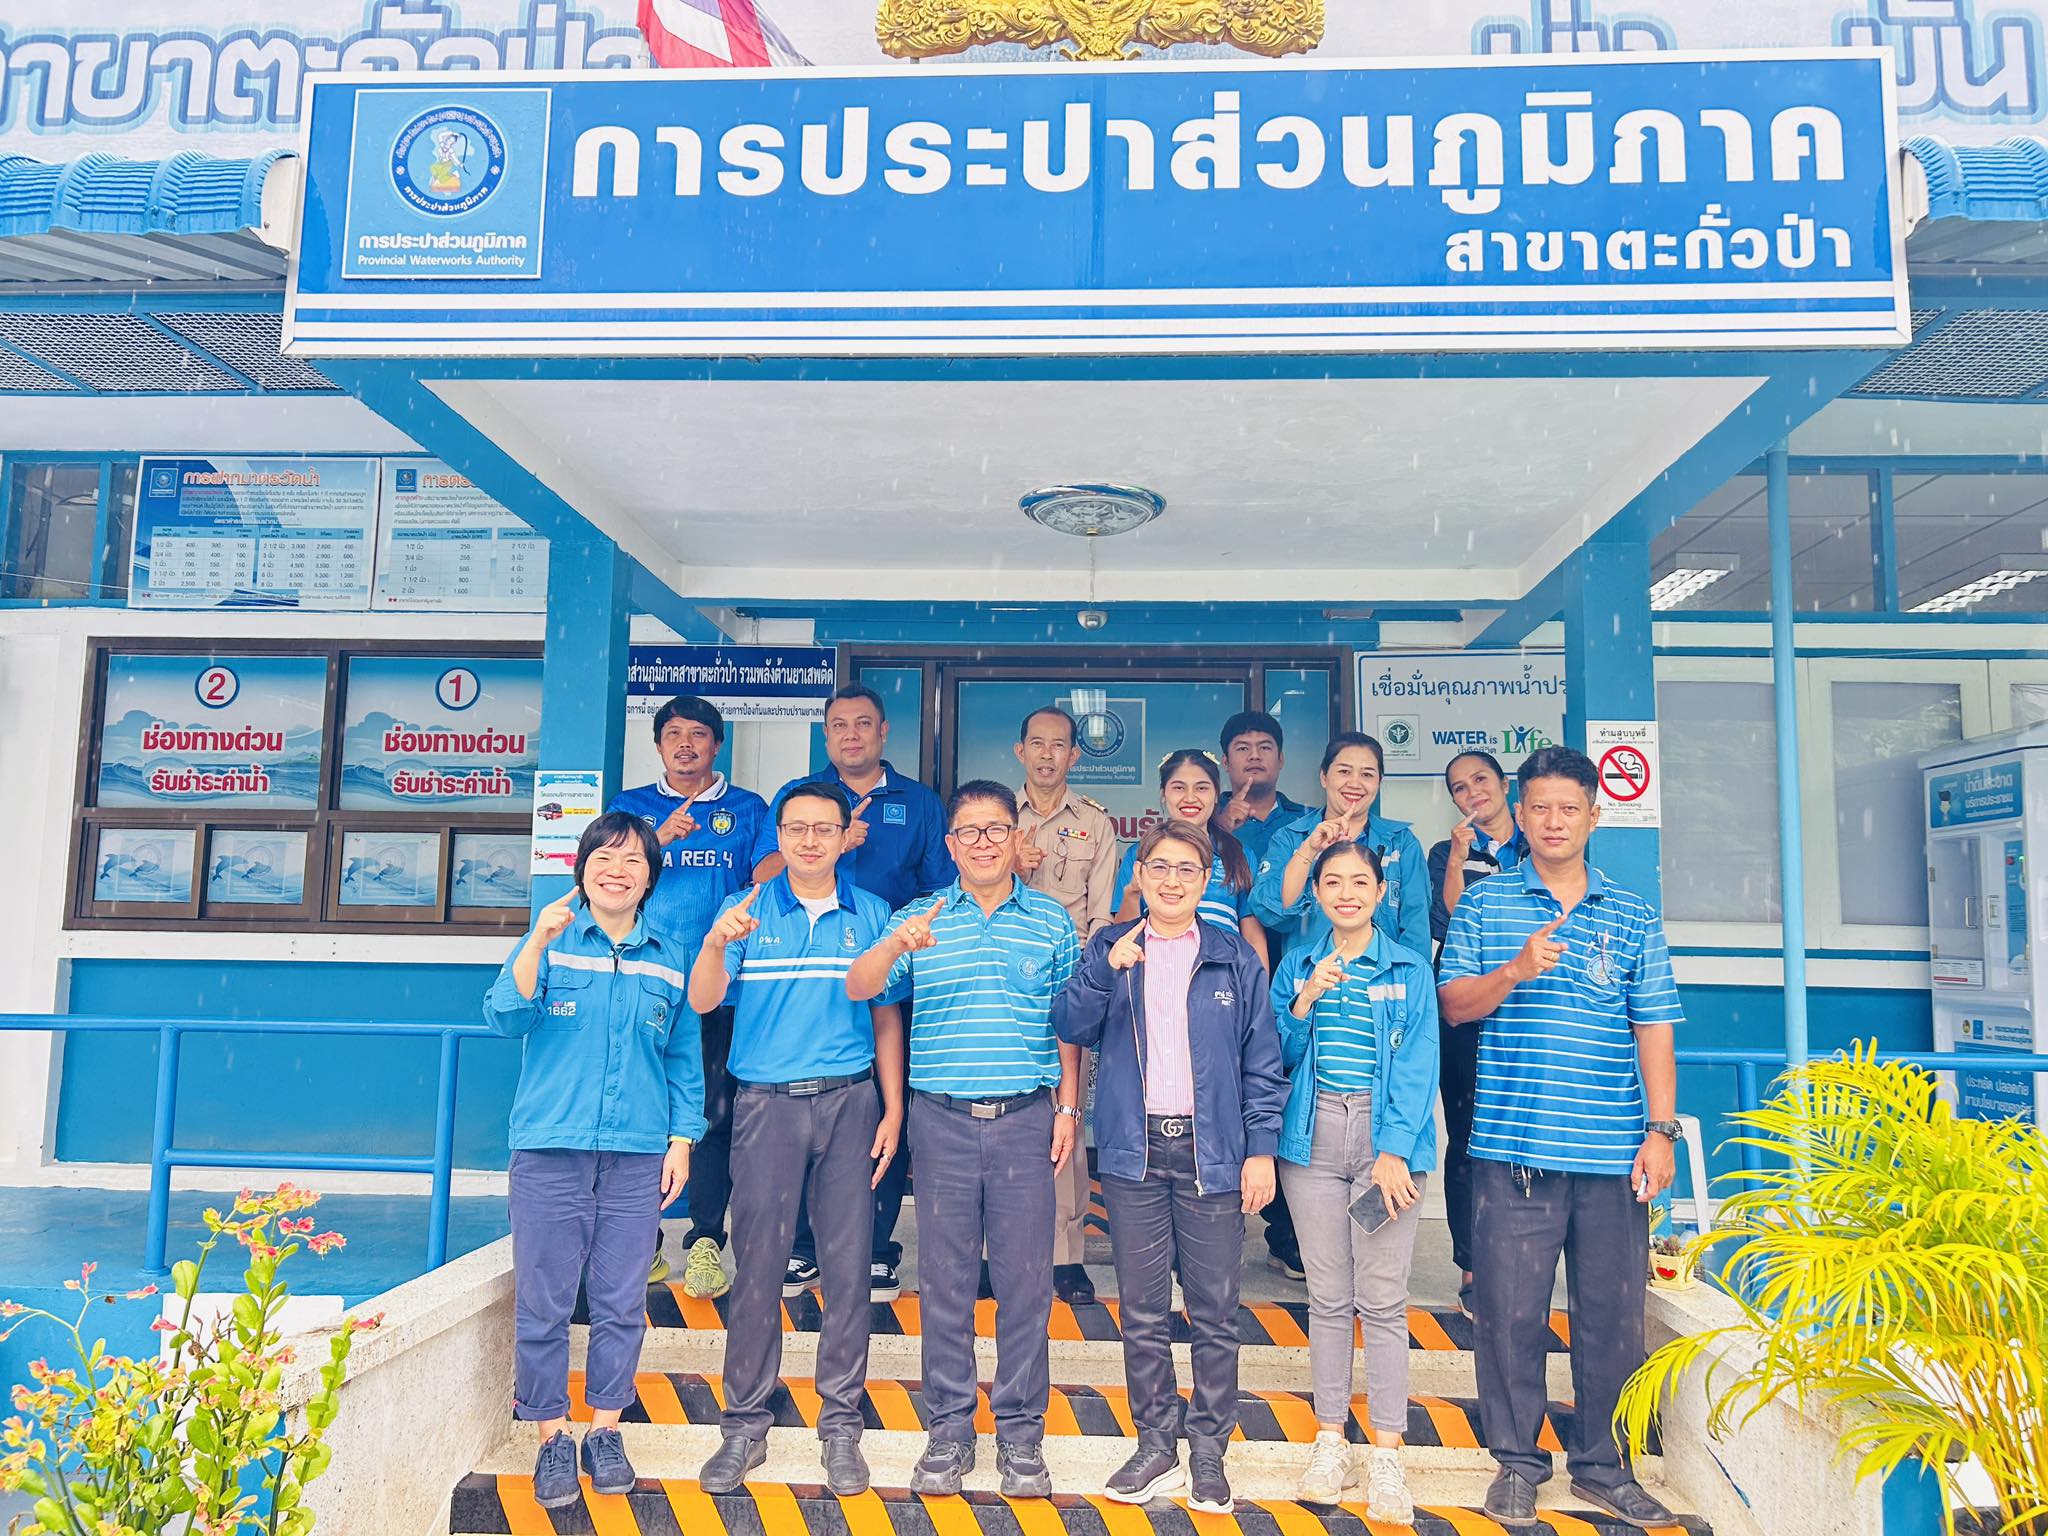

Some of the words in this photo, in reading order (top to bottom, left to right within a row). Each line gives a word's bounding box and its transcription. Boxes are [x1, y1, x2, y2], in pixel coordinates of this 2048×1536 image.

[571, 90, 1845, 215] การประปาส่วนภูมิภาค
[359, 231, 527, 253] การประปาส่วนภูมิภาค
[1445, 204, 1852, 272] สาขาตะกั่วป่า
[358, 254, 406, 266] Provincial
[410, 254, 472, 266] Waterworks
[476, 254, 525, 268] Authority
[422, 474, 478, 488] การตร
[739, 657, 834, 685] รวมพลังต้านยาเสพติด
[207, 673, 226, 701] 2
[449, 674, 463, 702] 1
[143, 723, 283, 752] ช่องทางด่วน
[385, 726, 525, 755] ช่องทางด่วน
[1432, 731, 1487, 745] WATER
[1489, 735, 1498, 745] is
[1599, 726, 1647, 740] ห้ามสูบบุหรี่
[150, 763, 269, 794] รับชำระค่าน้ำ
[393, 767, 511, 796] รับชำระค่าน้ำ
[546, 1006, 577, 1016] 1662
